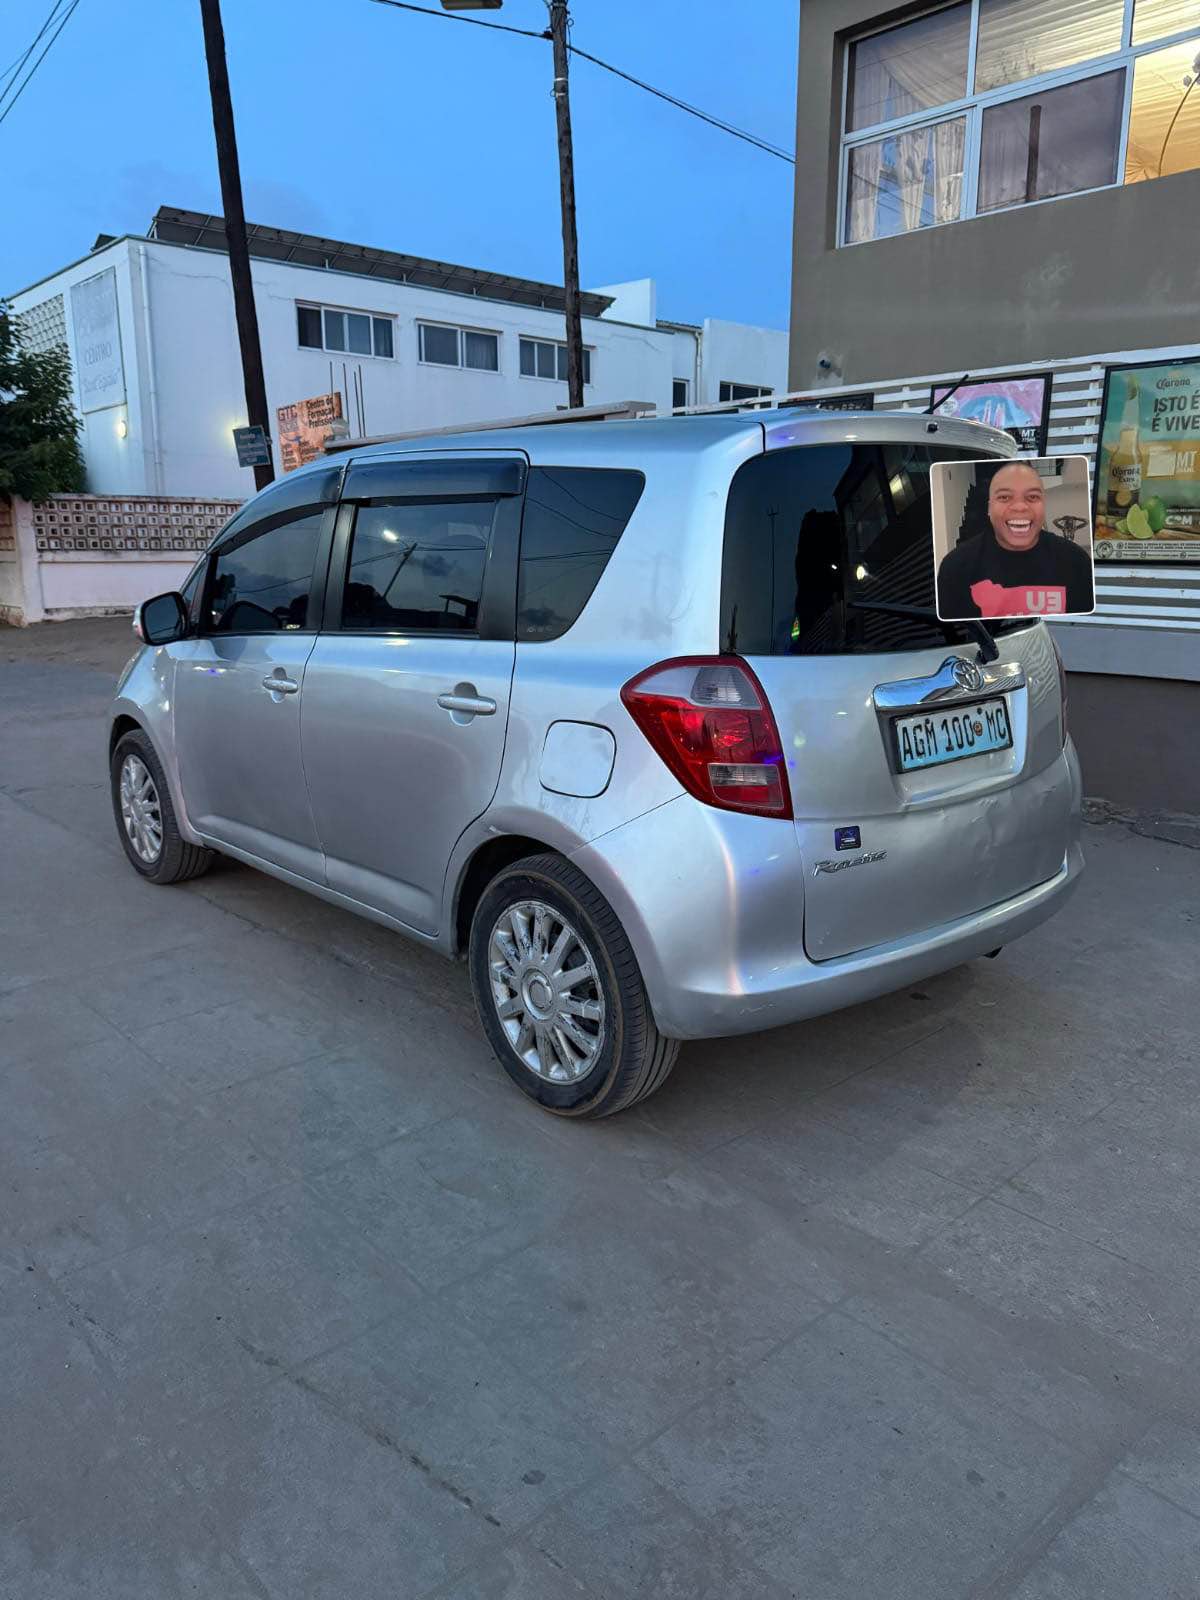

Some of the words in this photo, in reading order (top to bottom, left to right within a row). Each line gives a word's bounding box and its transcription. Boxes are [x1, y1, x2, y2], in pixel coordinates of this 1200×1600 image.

[1153, 394, 1187, 413] ISTO
[1152, 413, 1161, 432] É
[902, 719, 938, 762] AGM
[985, 708, 1006, 743] MC
